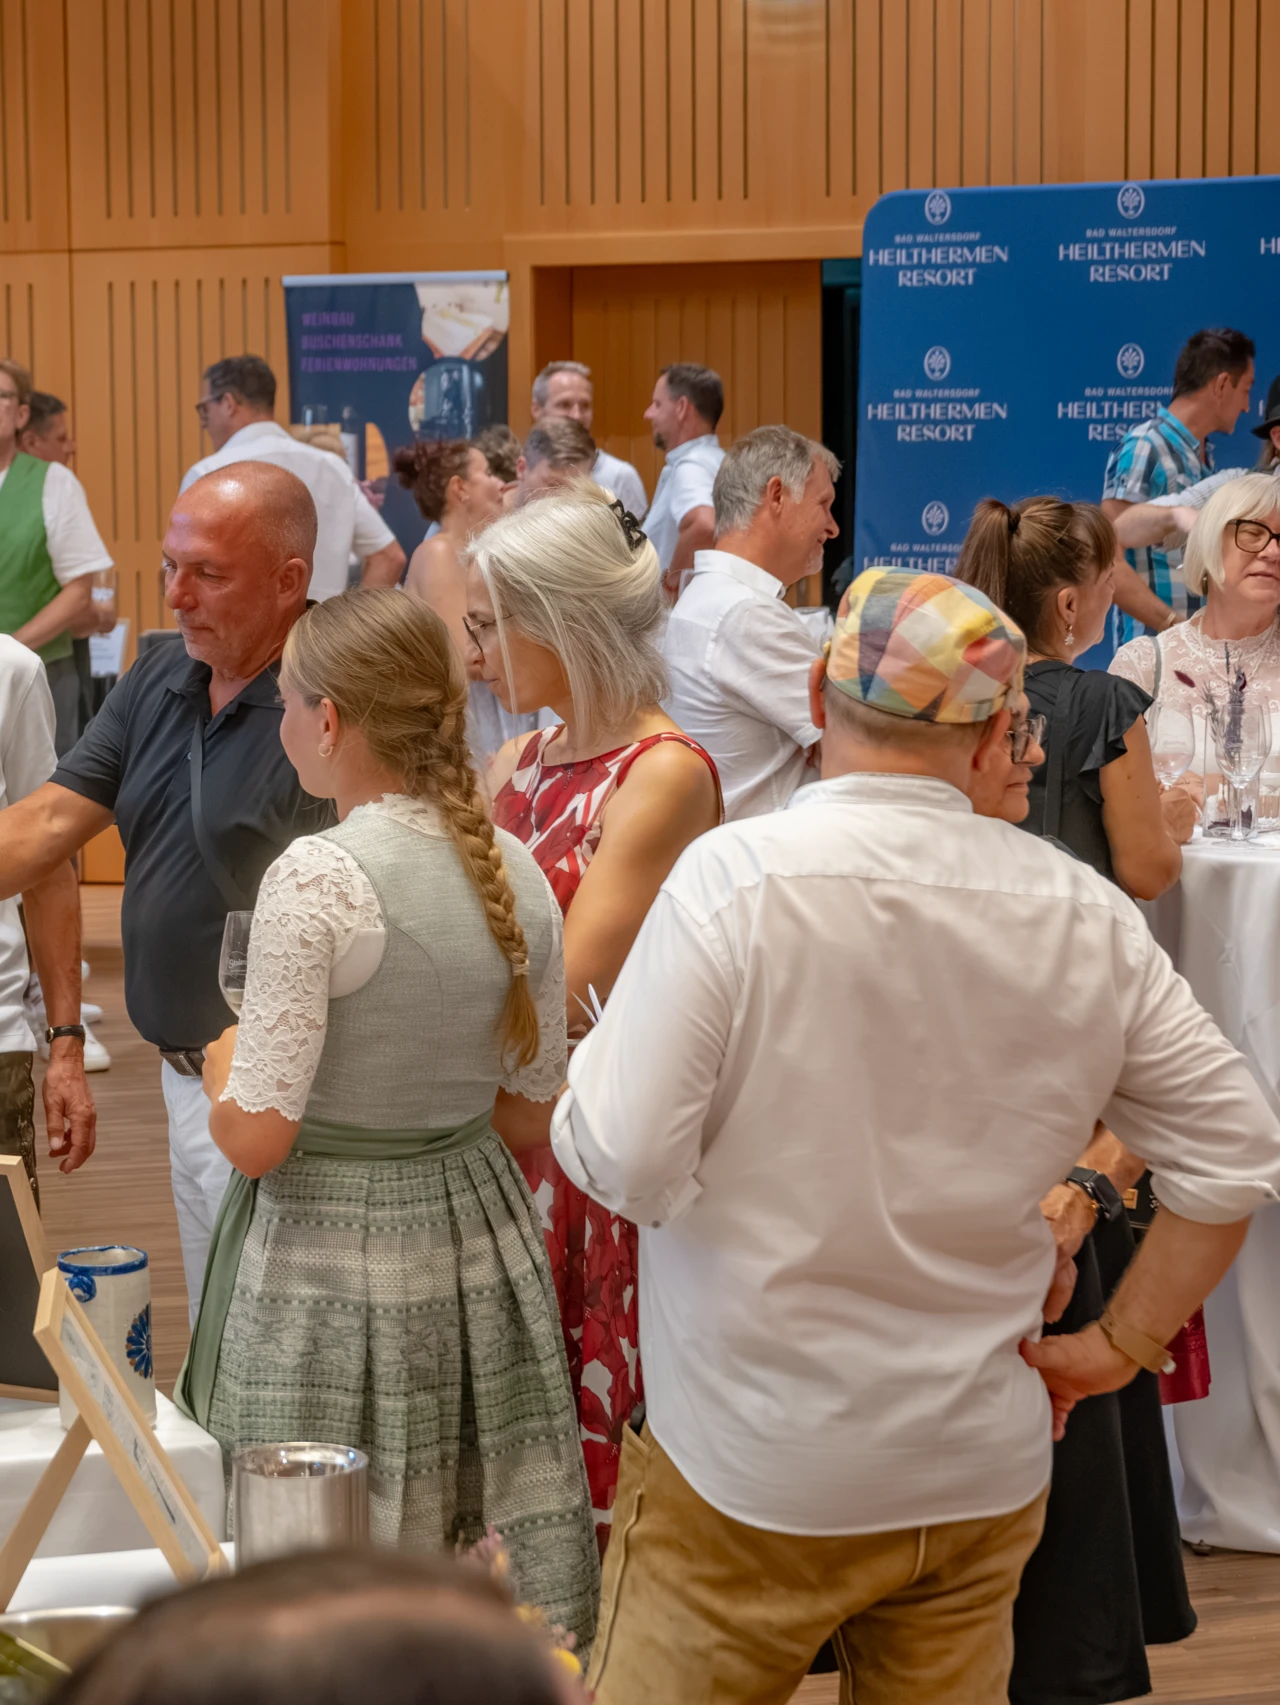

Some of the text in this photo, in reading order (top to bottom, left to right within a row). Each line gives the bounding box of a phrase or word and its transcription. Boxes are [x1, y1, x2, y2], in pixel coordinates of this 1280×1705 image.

[894, 232, 981, 244] BAD WALTERSDORF
[1086, 226, 1177, 238] BAD WALTERSDORF
[869, 245, 1009, 266] HEILTHERMEN
[1058, 240, 1206, 261] HEILTHERMEN
[898, 268, 977, 287] RESORT
[1089, 263, 1173, 283] RESORT
[300, 356, 418, 372] FERIENWOHNUNGEN
[893, 388, 980, 399] BAD WALTERSDORF
[1084, 387, 1104, 397] BAD
[867, 402, 1007, 420] HEILTHERMEN
[1057, 401, 1163, 419] HEILTHER
[896, 424, 976, 442] RESORT
[1088, 423, 1138, 441] RES
[890, 543, 910, 553] BAD
[863, 556, 958, 575] HEILTHER
